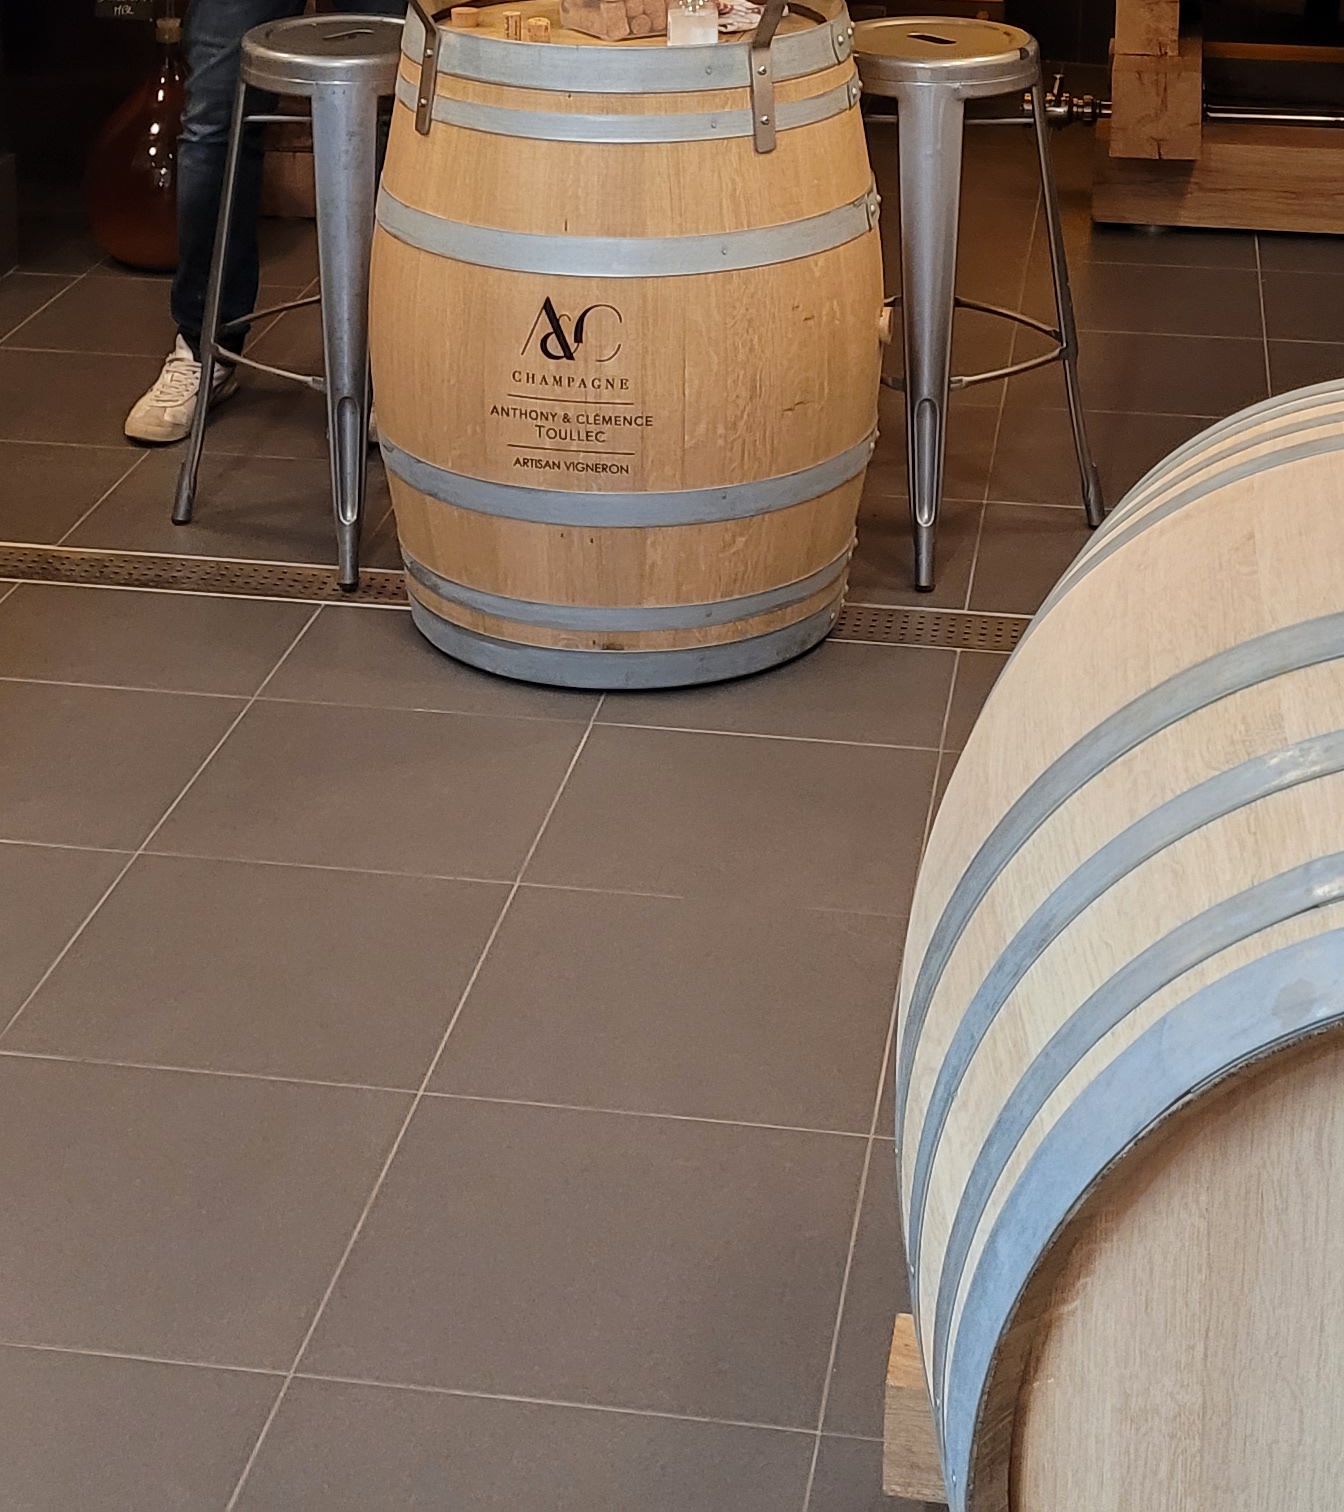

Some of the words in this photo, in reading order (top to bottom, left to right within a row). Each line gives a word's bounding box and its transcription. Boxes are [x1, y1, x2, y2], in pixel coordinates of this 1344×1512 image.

[512, 370, 630, 390] CHAMPAGNE
[490, 405, 558, 424] ANTHONY
[561, 412, 572, 424] &
[576, 412, 654, 427] CLÉMENCE
[534, 424, 607, 444] TOULLEC
[513, 456, 561, 471] ARTISAN
[563, 461, 630, 475] VIGNERON
